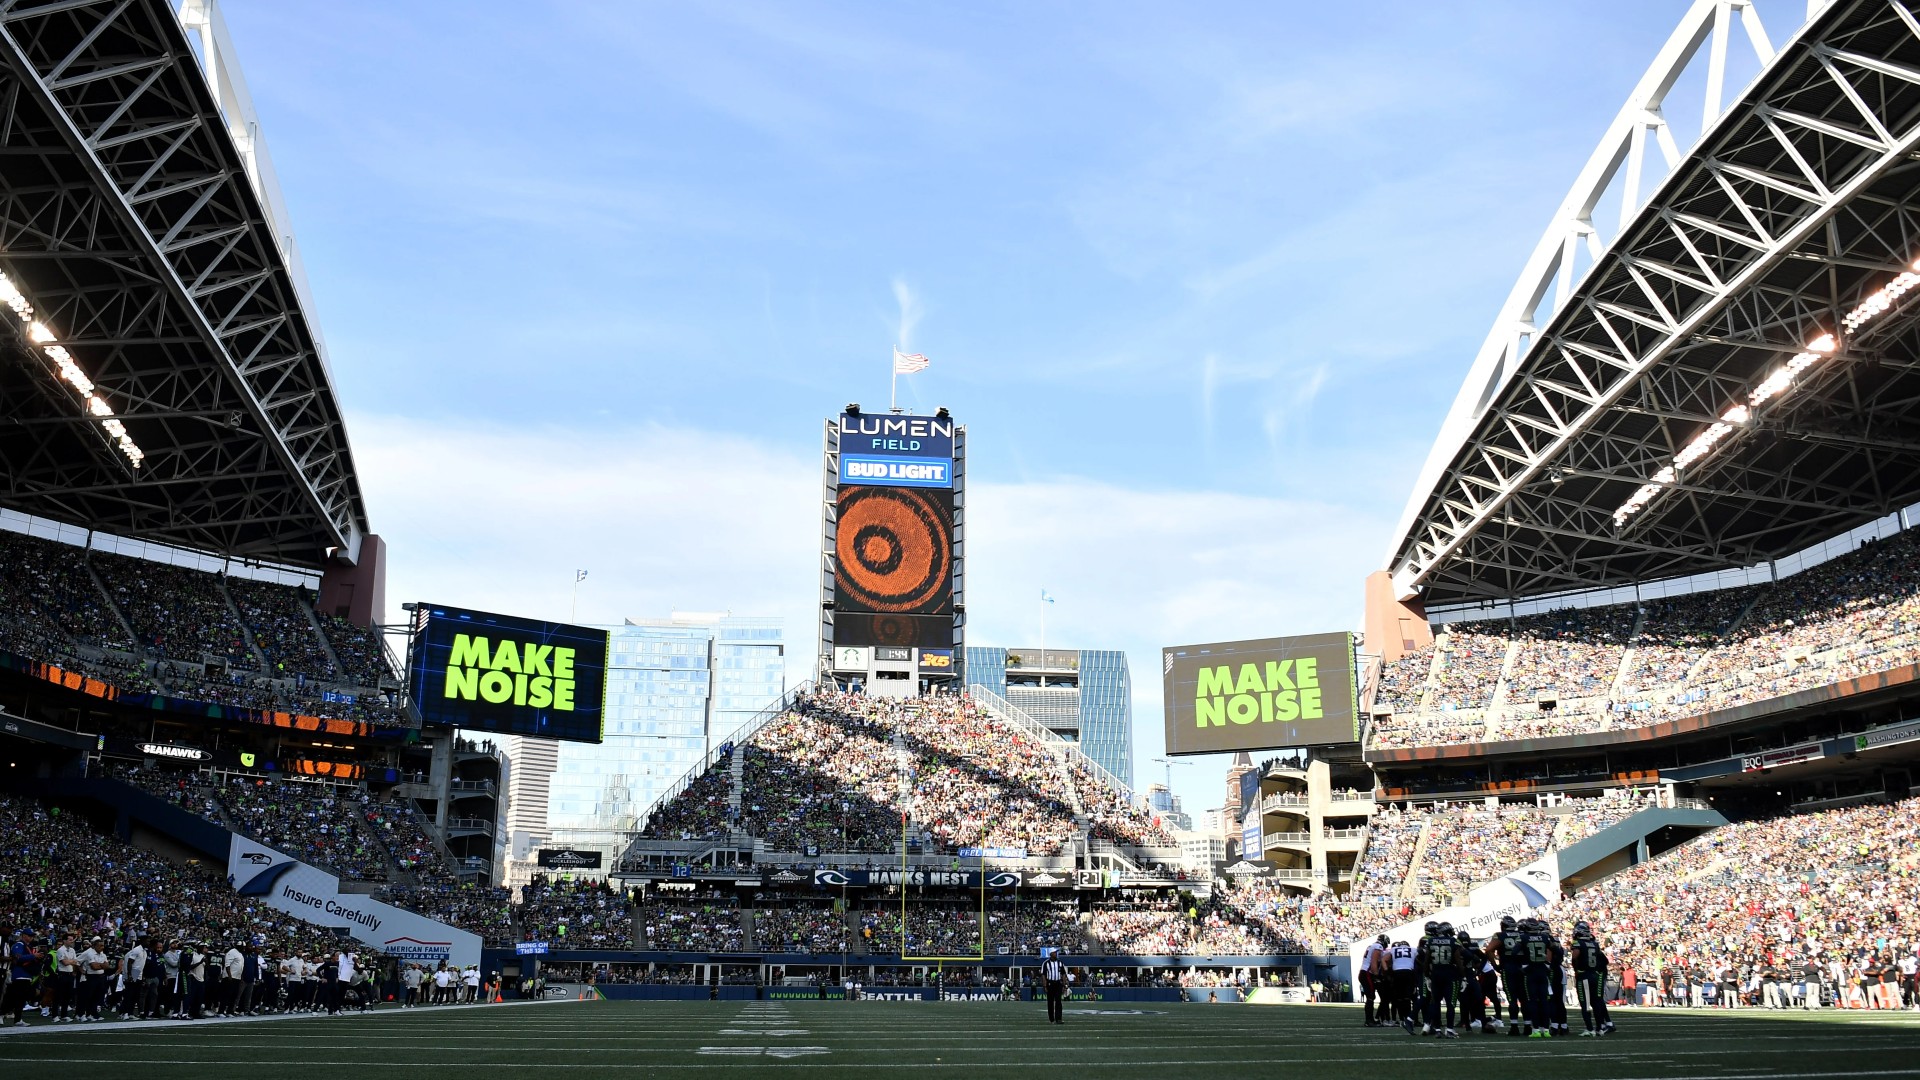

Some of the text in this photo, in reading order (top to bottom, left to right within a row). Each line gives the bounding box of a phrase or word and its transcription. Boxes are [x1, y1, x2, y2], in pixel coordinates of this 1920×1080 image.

[841, 417, 951, 438] LUMEN
[872, 439, 921, 451] FIELD
[848, 462, 945, 480] BUD LIGHT
[450, 633, 575, 679] MAKE
[888, 650, 908, 659] 1:44
[1196, 657, 1319, 697] MAKE
[445, 665, 575, 711] NOISE
[1195, 688, 1323, 728] NOISE
[143, 744, 201, 759] SEAHAWKS
[1743, 756, 1761, 769] EQC
[960, 849, 980, 857] FEEL
[676, 866, 687, 877] 12
[868, 872, 970, 886] HAWKS NEST
[1081, 872, 1098, 885] 27
[283, 885, 382, 931] Insure Carefully
[1470, 903, 1521, 928] Fearlessly
[385, 945, 423, 953] AMERICAN
[1394, 947, 1412, 959] 63
[1430, 945, 1452, 965] 30
[1527, 941, 1546, 962] 13
[859, 991, 922, 1001] SEATTLE
